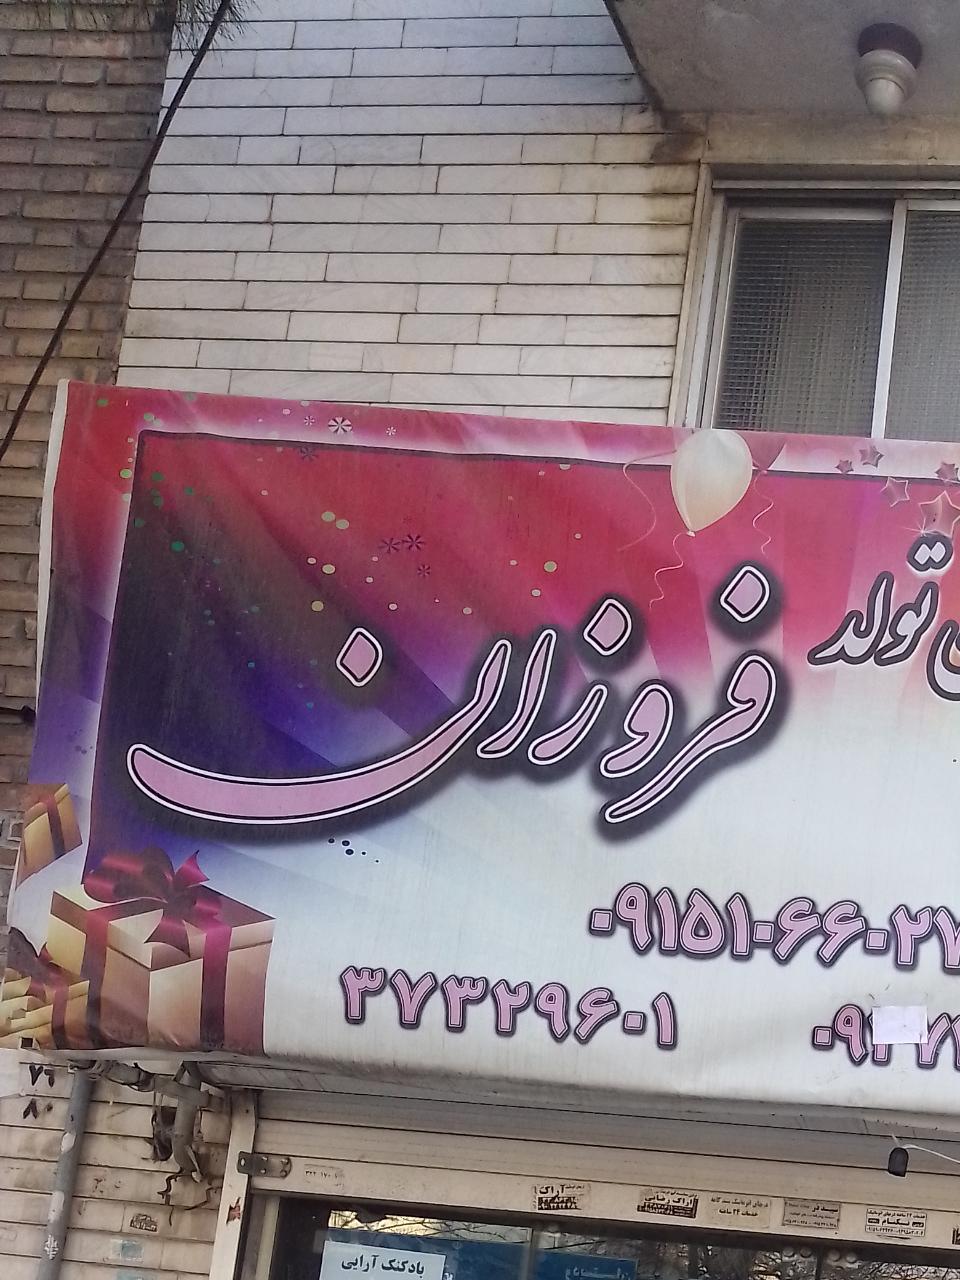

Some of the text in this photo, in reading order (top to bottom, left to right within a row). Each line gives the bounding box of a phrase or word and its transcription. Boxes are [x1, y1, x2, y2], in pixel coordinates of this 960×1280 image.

[809, 533, 953, 667] تولد
[127, 564, 779, 824] فروزان
[340, 965, 677, 1047] ۳۷۳۲۹۶۰۱
[341, 1254, 380, 1273] آرایی
[381, 1258, 425, 1279] بادکنک
